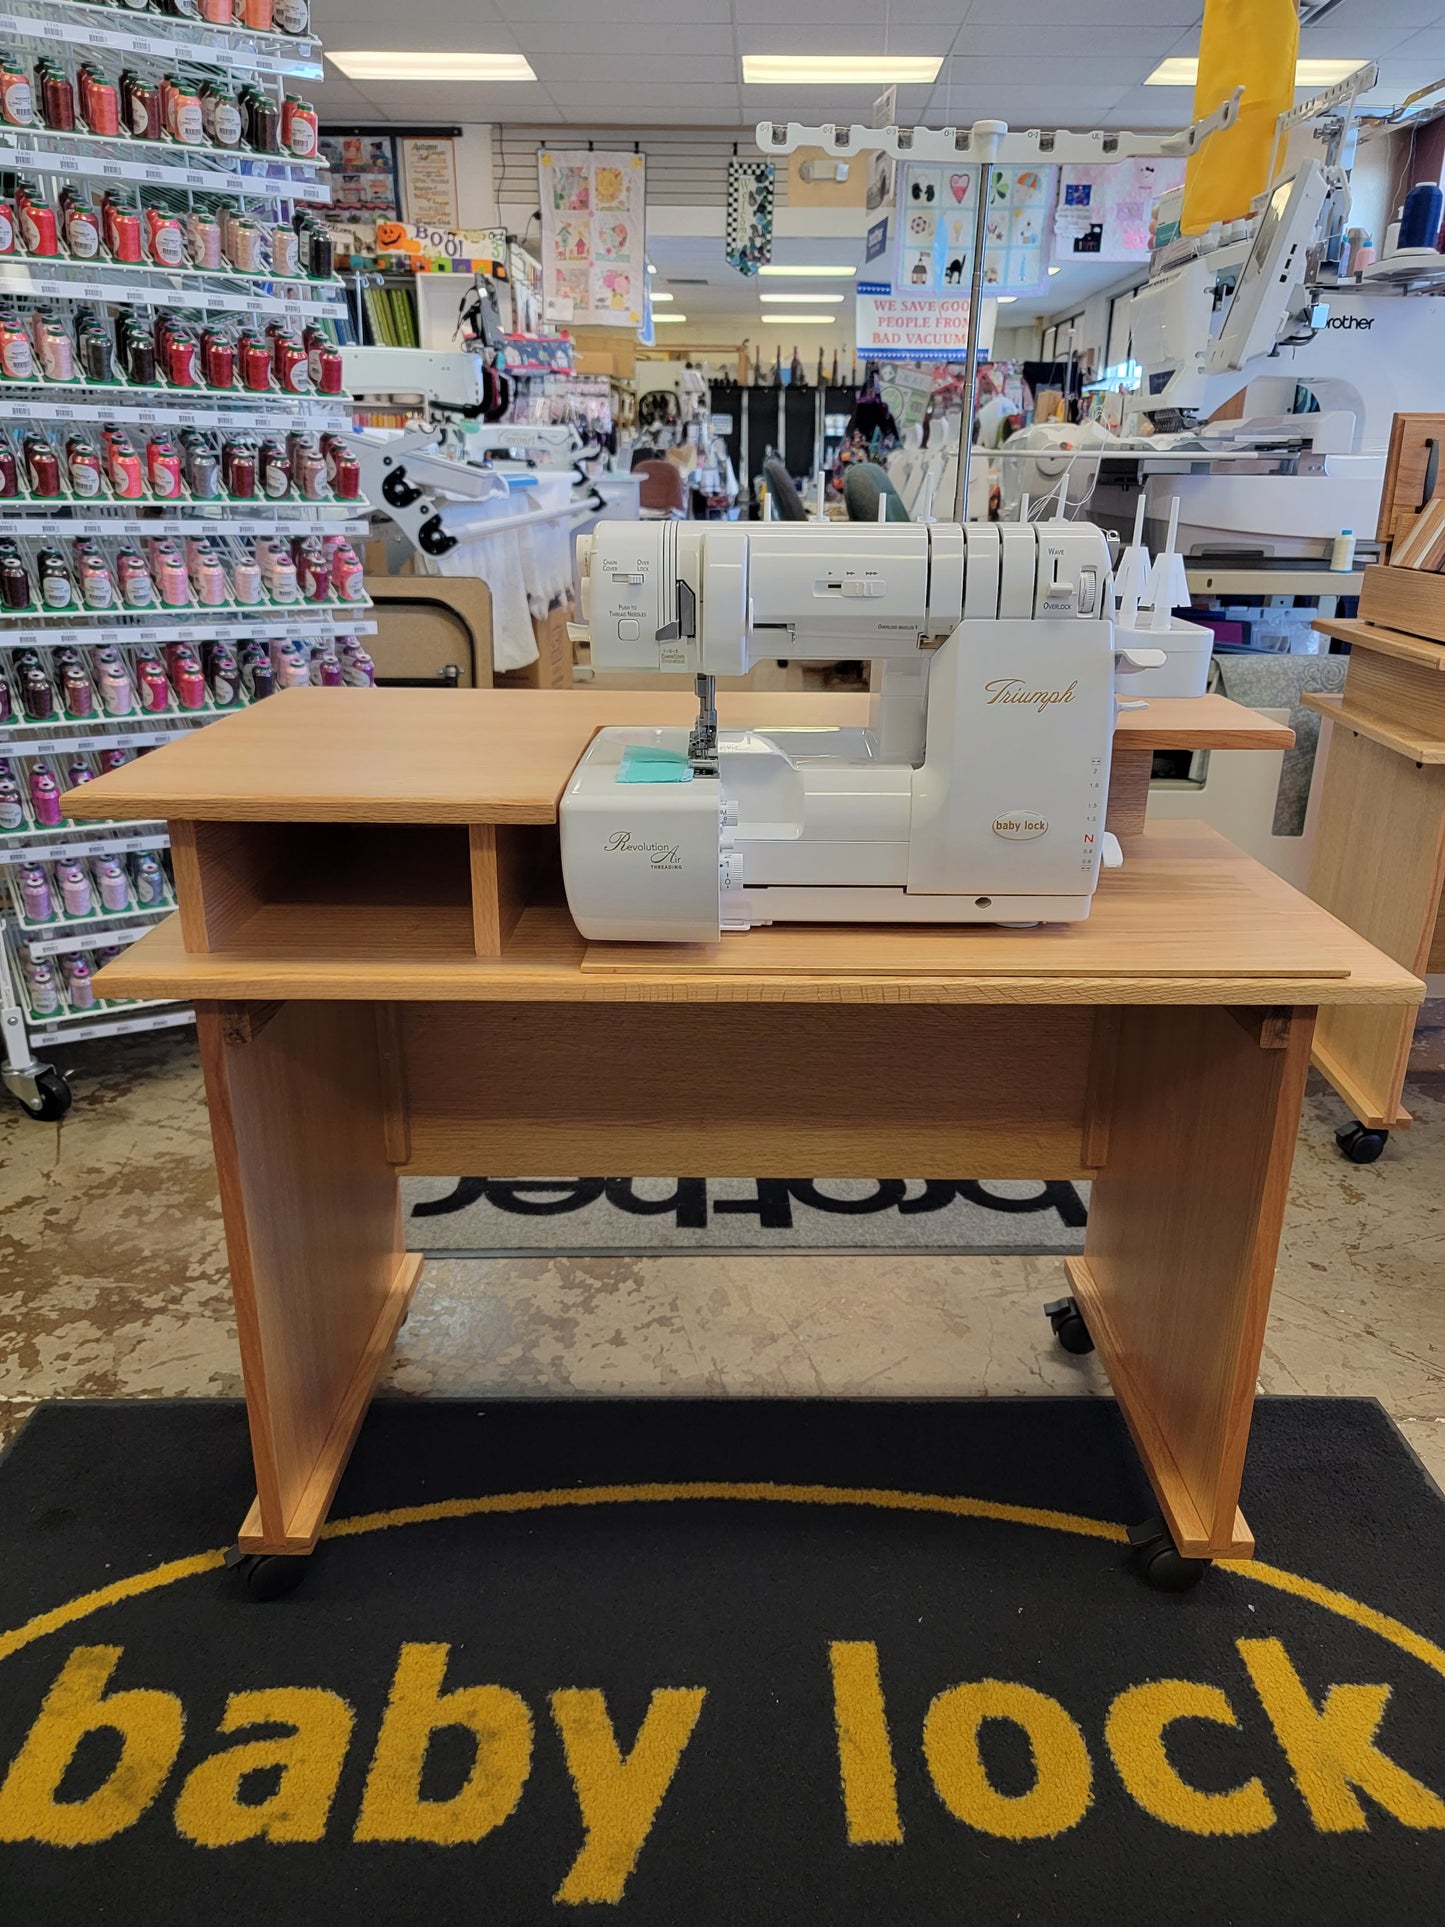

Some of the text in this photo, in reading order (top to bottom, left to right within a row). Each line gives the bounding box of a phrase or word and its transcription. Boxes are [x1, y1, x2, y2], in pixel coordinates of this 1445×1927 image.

[874, 300, 969, 312] WE SAVE GOO
[878, 316, 931, 328] PEOPLE
[1326, 314, 1375, 330] rother
[872, 332, 901, 344] BAD
[984, 678, 1079, 713] Triumph
[996, 820, 1045, 832] baby lock
[603, 831, 669, 852] Revolution
[1084, 833, 1094, 843] N
[650, 845, 681, 864] Air
[0, 1637, 1445, 1905] baby lock
